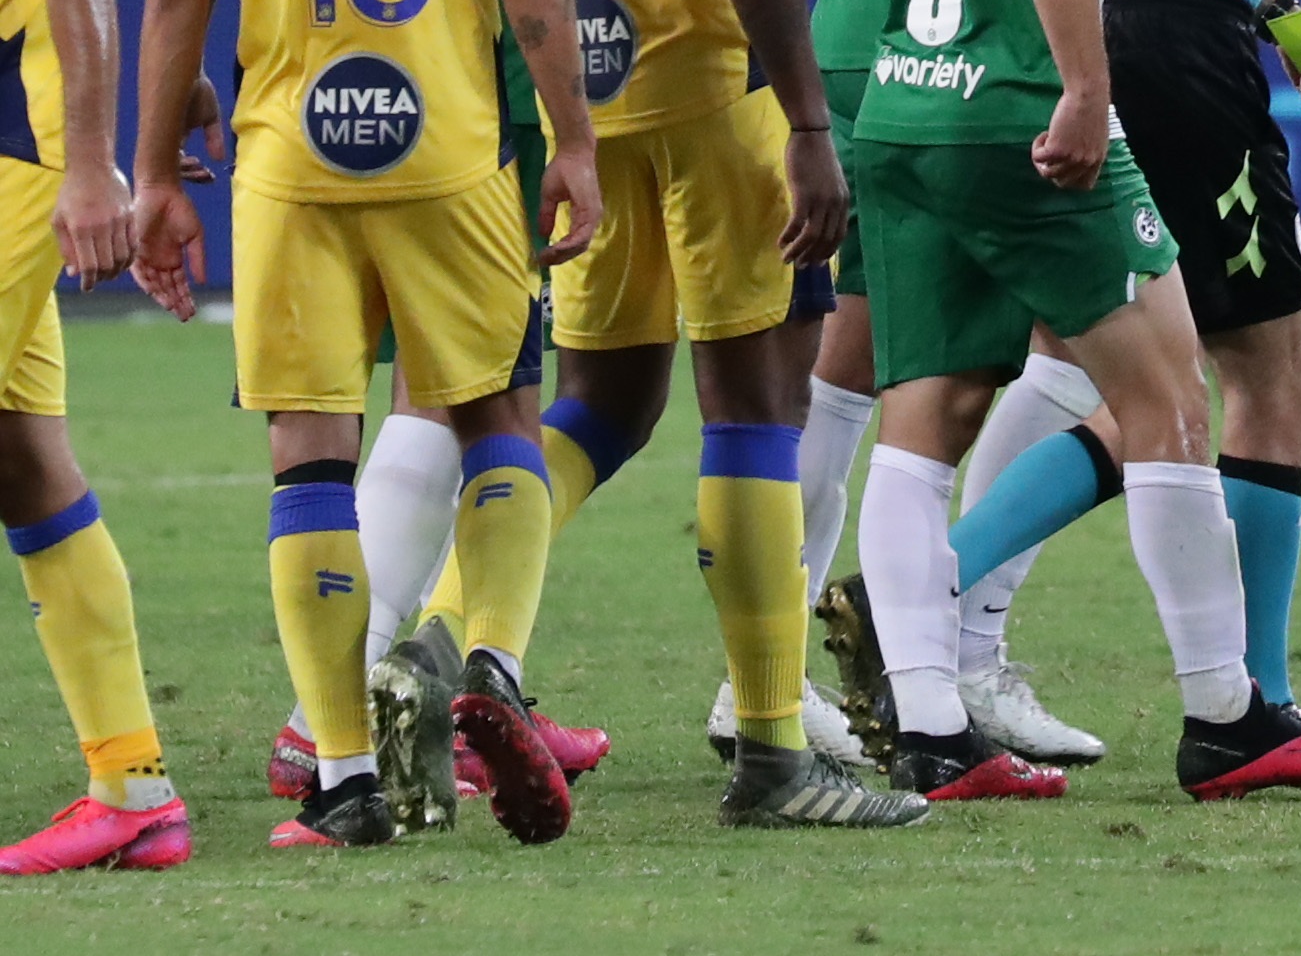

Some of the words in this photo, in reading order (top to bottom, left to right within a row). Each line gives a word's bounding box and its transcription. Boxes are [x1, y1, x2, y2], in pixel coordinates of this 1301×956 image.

[575, 15, 631, 45] IVEA
[893, 53, 986, 100] variety
[313, 87, 418, 115] NIVEA
[320, 119, 406, 146] MEN
